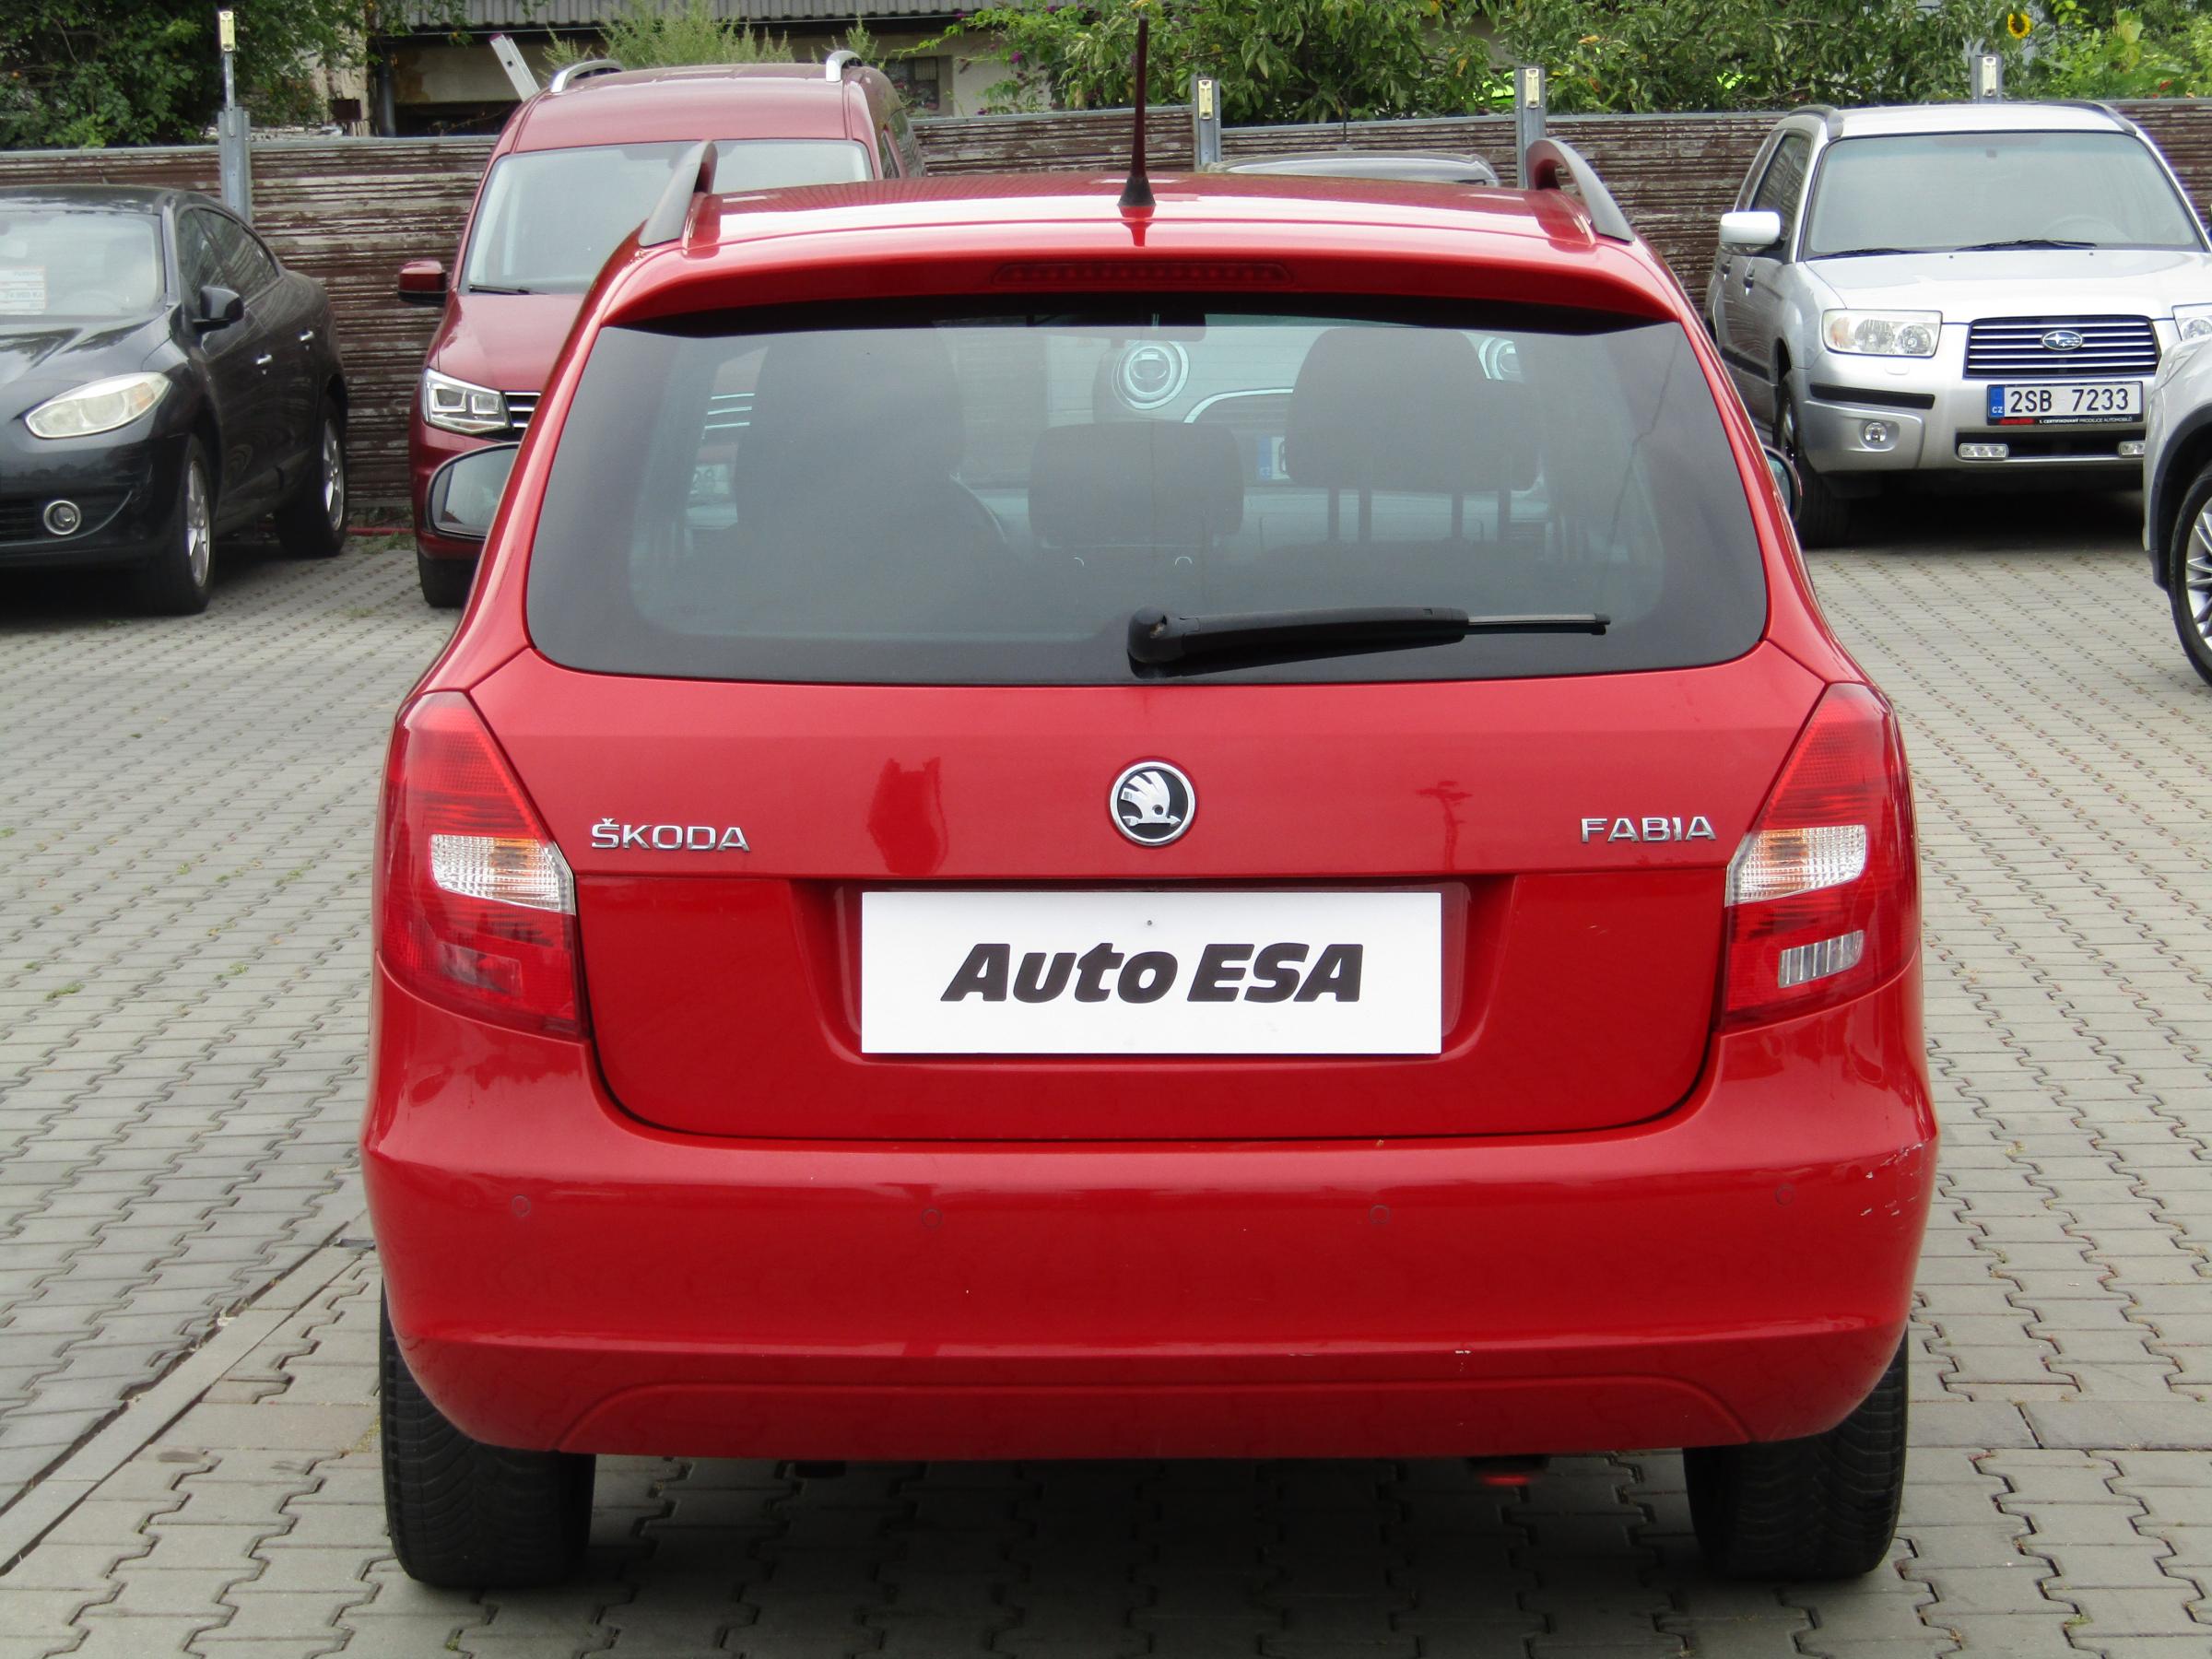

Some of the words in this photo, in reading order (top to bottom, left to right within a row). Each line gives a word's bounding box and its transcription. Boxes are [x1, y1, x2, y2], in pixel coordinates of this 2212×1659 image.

[1992, 406, 2004, 414] CZ
[2010, 390, 2053, 413] 2SB
[2071, 388, 2129, 412] 7233
[591, 818, 751, 852] ŠKODA
[1581, 816, 1717, 843] FABIA
[940, 942, 1179, 1004] Auto
[1187, 942, 1364, 1003] ESA
